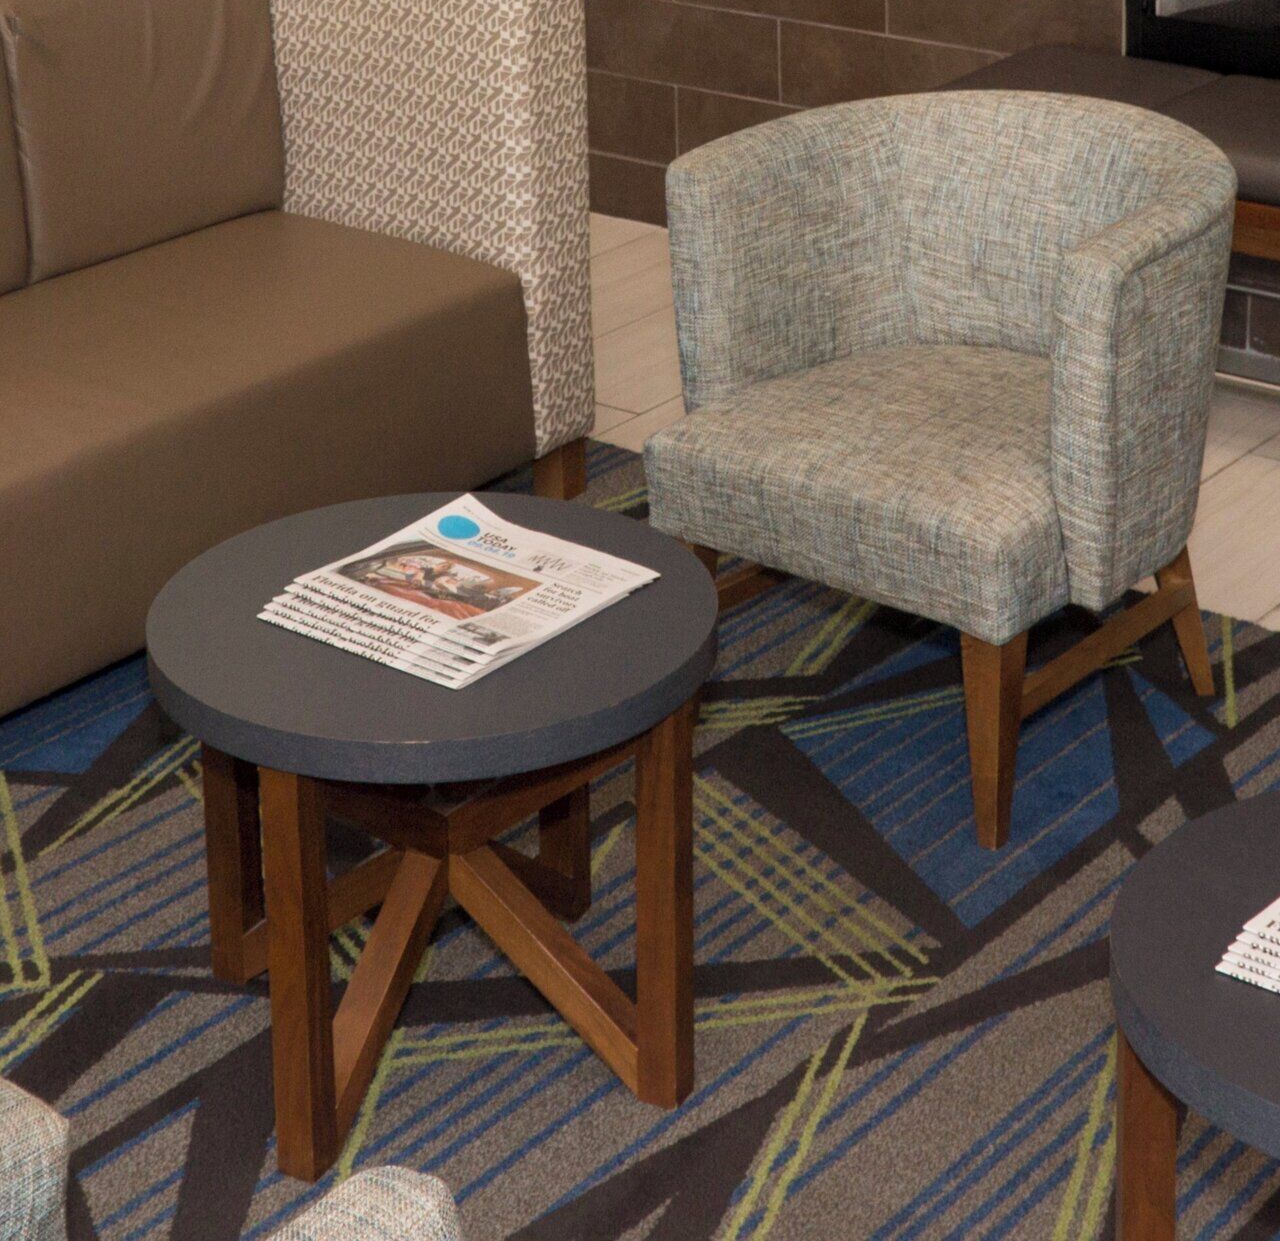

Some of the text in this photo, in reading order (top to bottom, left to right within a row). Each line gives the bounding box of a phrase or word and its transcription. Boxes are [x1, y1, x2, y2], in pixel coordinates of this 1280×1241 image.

[477, 536, 517, 551] TODAY
[483, 532, 508, 544] USA
[311, 574, 440, 625] Florida on guard for
